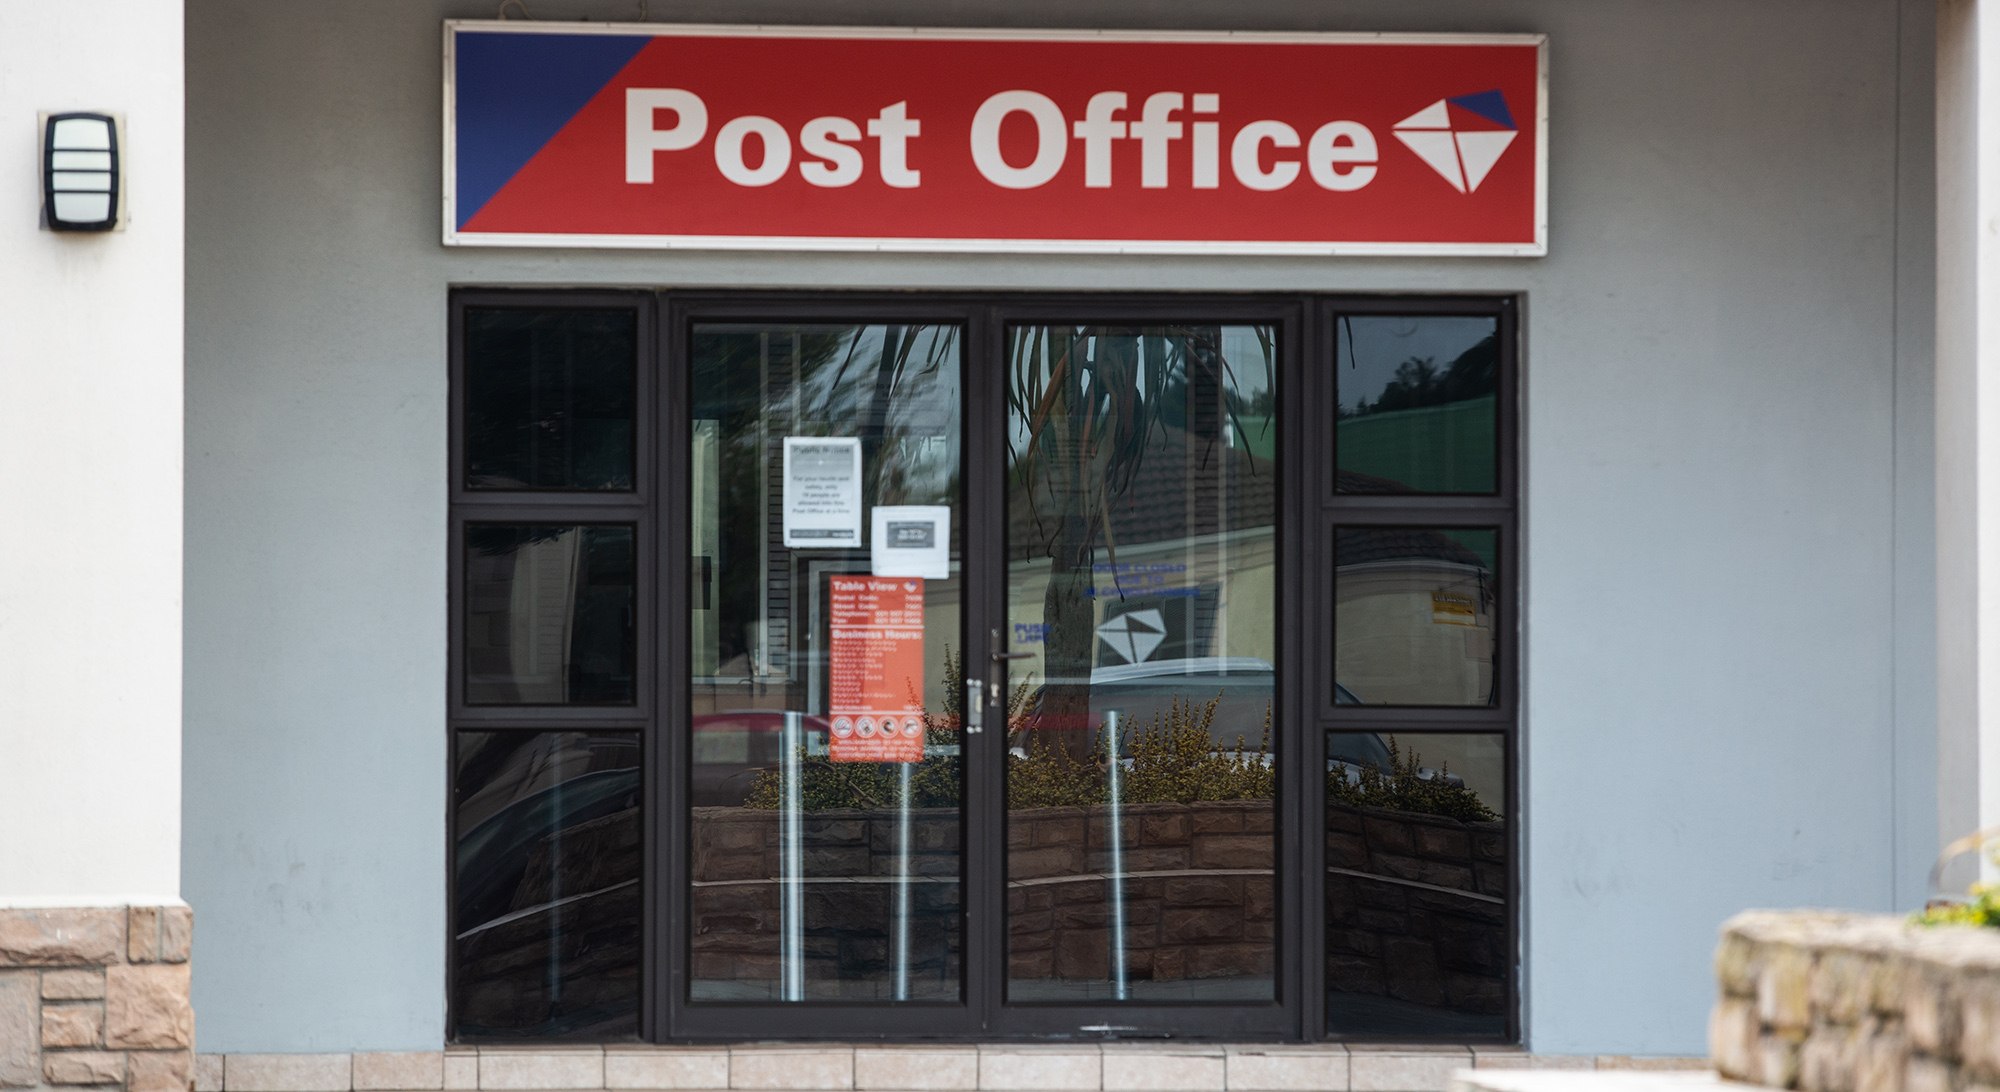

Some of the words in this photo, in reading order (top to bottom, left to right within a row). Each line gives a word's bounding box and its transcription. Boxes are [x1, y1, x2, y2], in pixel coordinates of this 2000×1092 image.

[625, 87, 922, 189] Post
[969, 89, 1379, 193] Office
[1092, 563, 1131, 573] DOOR
[1115, 575, 1143, 584] DUE
[1146, 575, 1165, 584] TO
[833, 580, 866, 591] Table
[867, 580, 898, 591] View
[1101, 587, 1200, 597] CONDITIONING
[1014, 623, 1051, 633] PUSH
[832, 630, 883, 639] Business
[884, 630, 923, 640] Hours:
